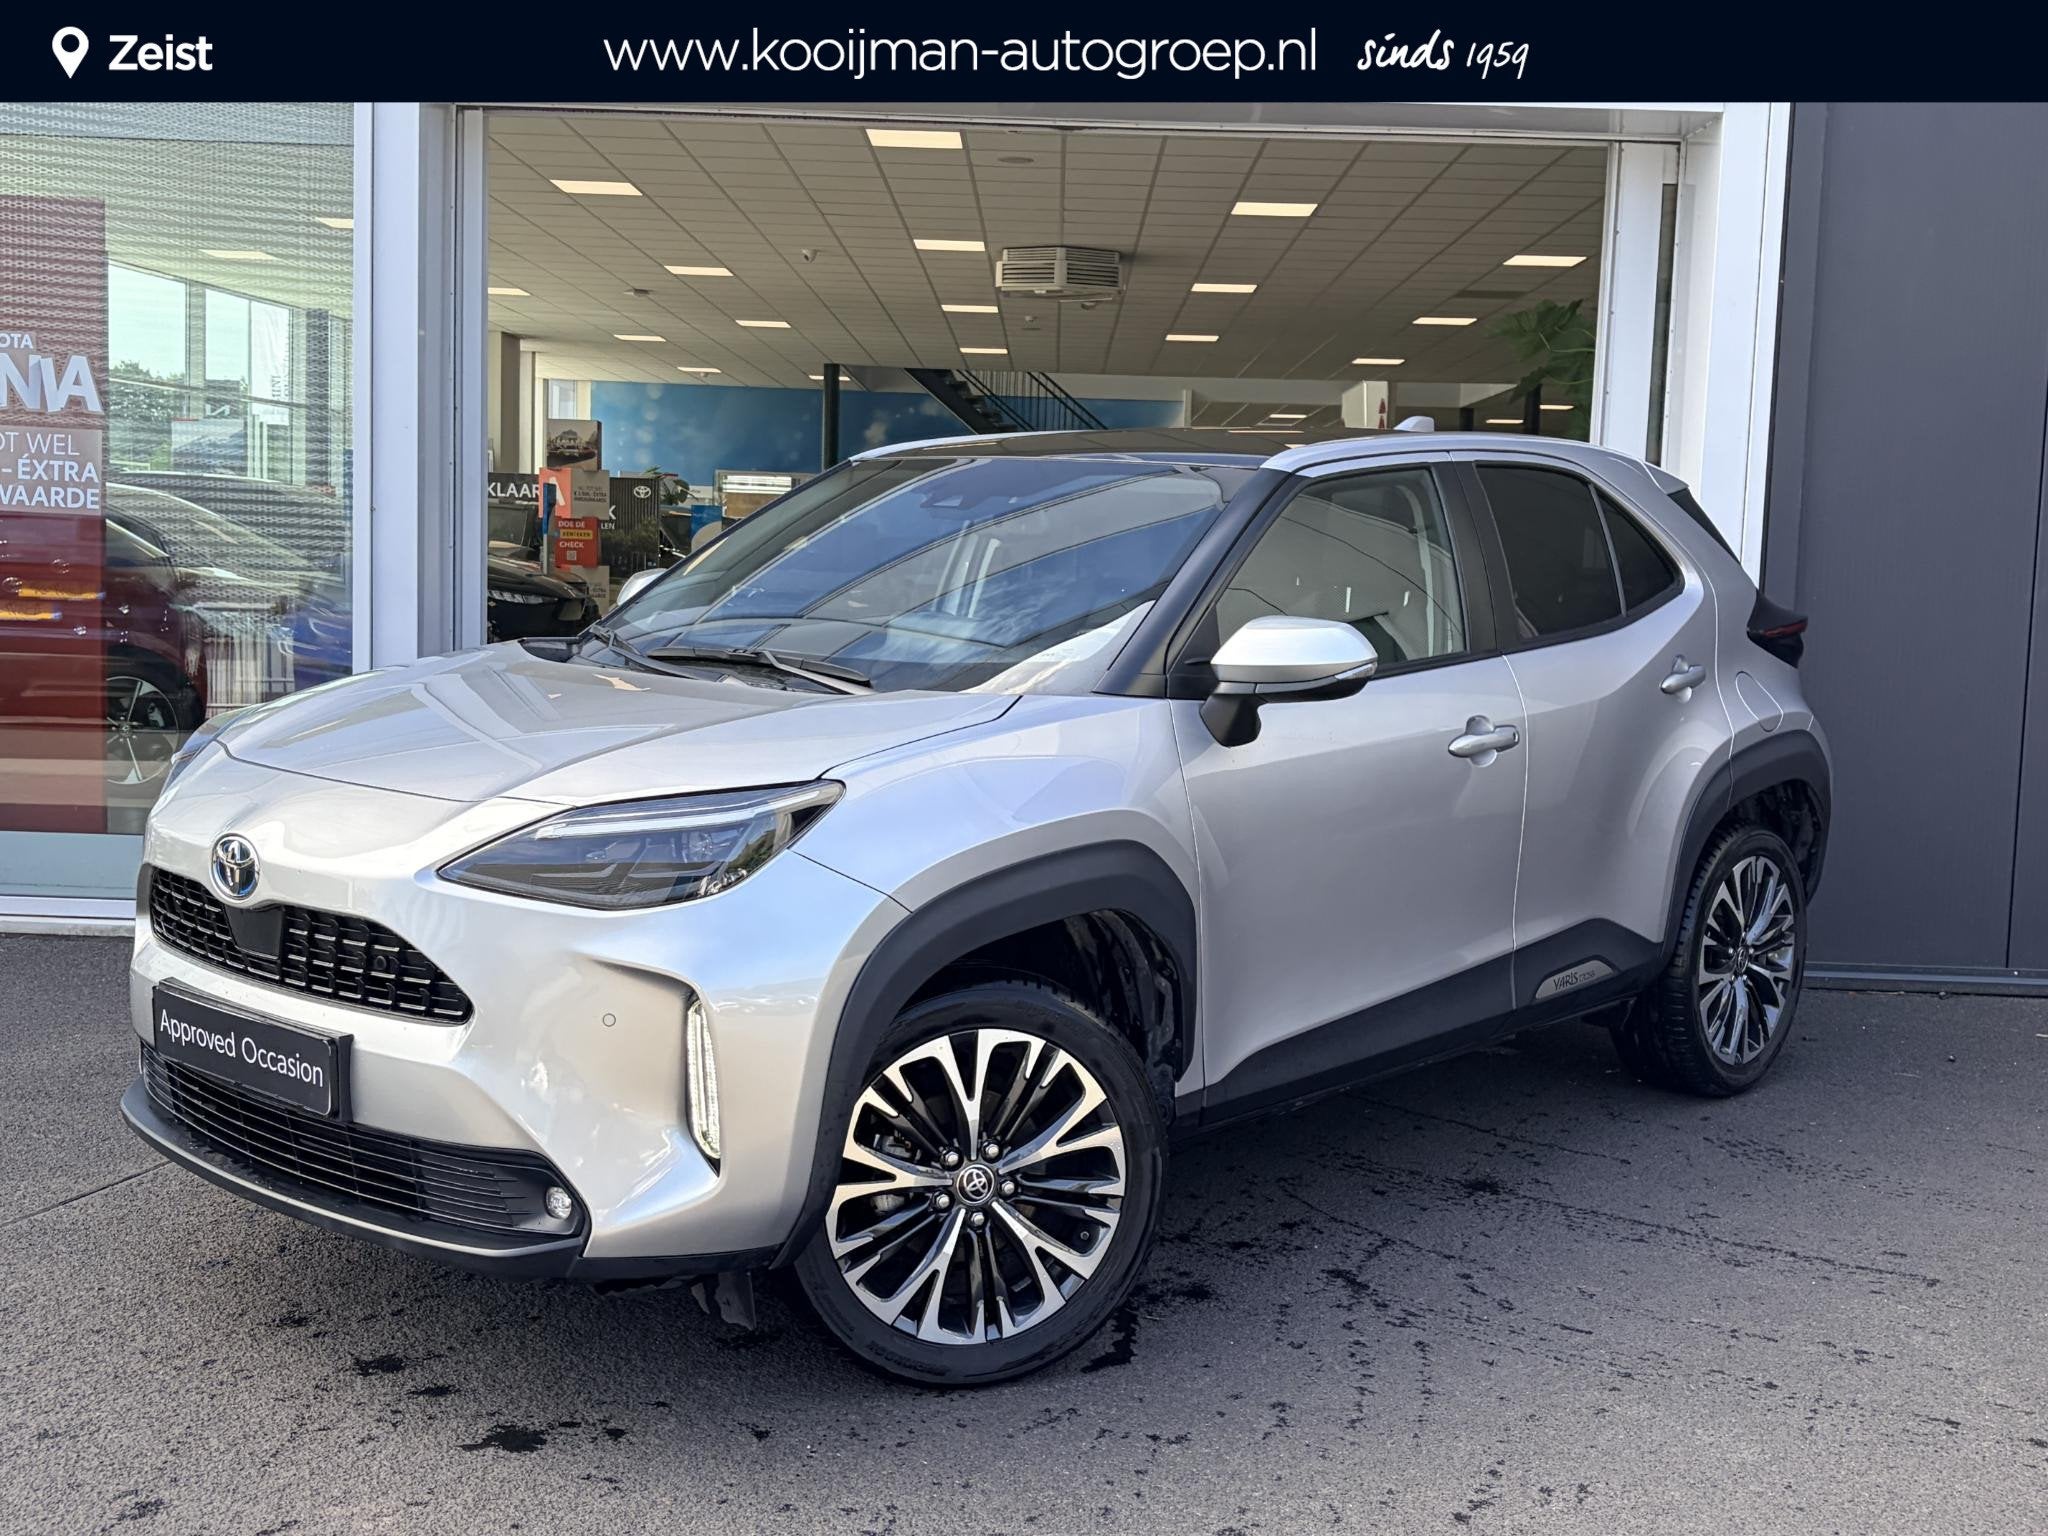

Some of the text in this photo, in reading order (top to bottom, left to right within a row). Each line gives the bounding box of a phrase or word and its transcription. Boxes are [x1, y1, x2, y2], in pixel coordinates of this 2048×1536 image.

[26, 432, 80, 456] WEL
[17, 453, 99, 483] ÉXTRA
[559, 541, 585, 549] CHECK
[1553, 971, 1579, 991] YARIS
[160, 1009, 324, 1088] Approved Occasion
